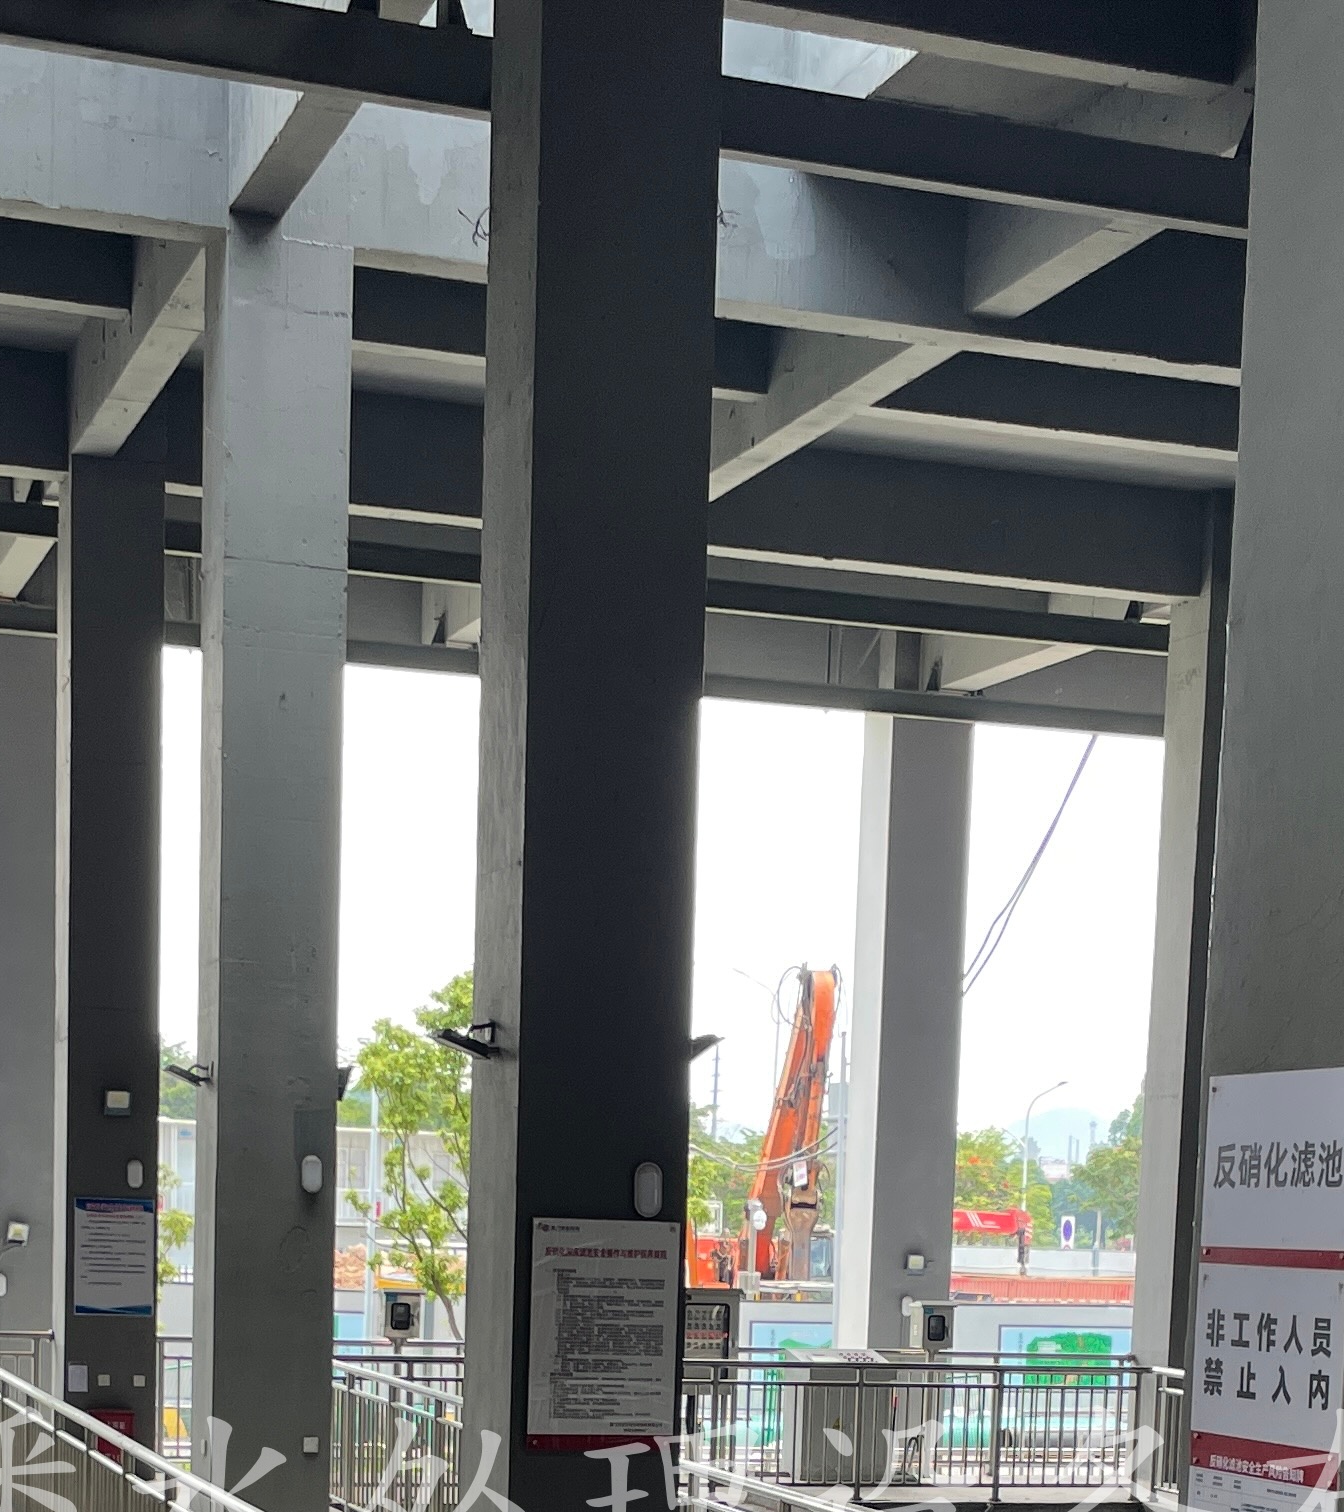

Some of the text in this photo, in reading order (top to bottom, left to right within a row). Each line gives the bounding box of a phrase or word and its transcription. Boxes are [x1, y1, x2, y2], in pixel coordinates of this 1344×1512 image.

[1213, 1139, 1344, 1189] 反硝化滤池
[1206, 1308, 1332, 1359] 非工作人员
[1203, 1356, 1330, 1411] 禁止入内
